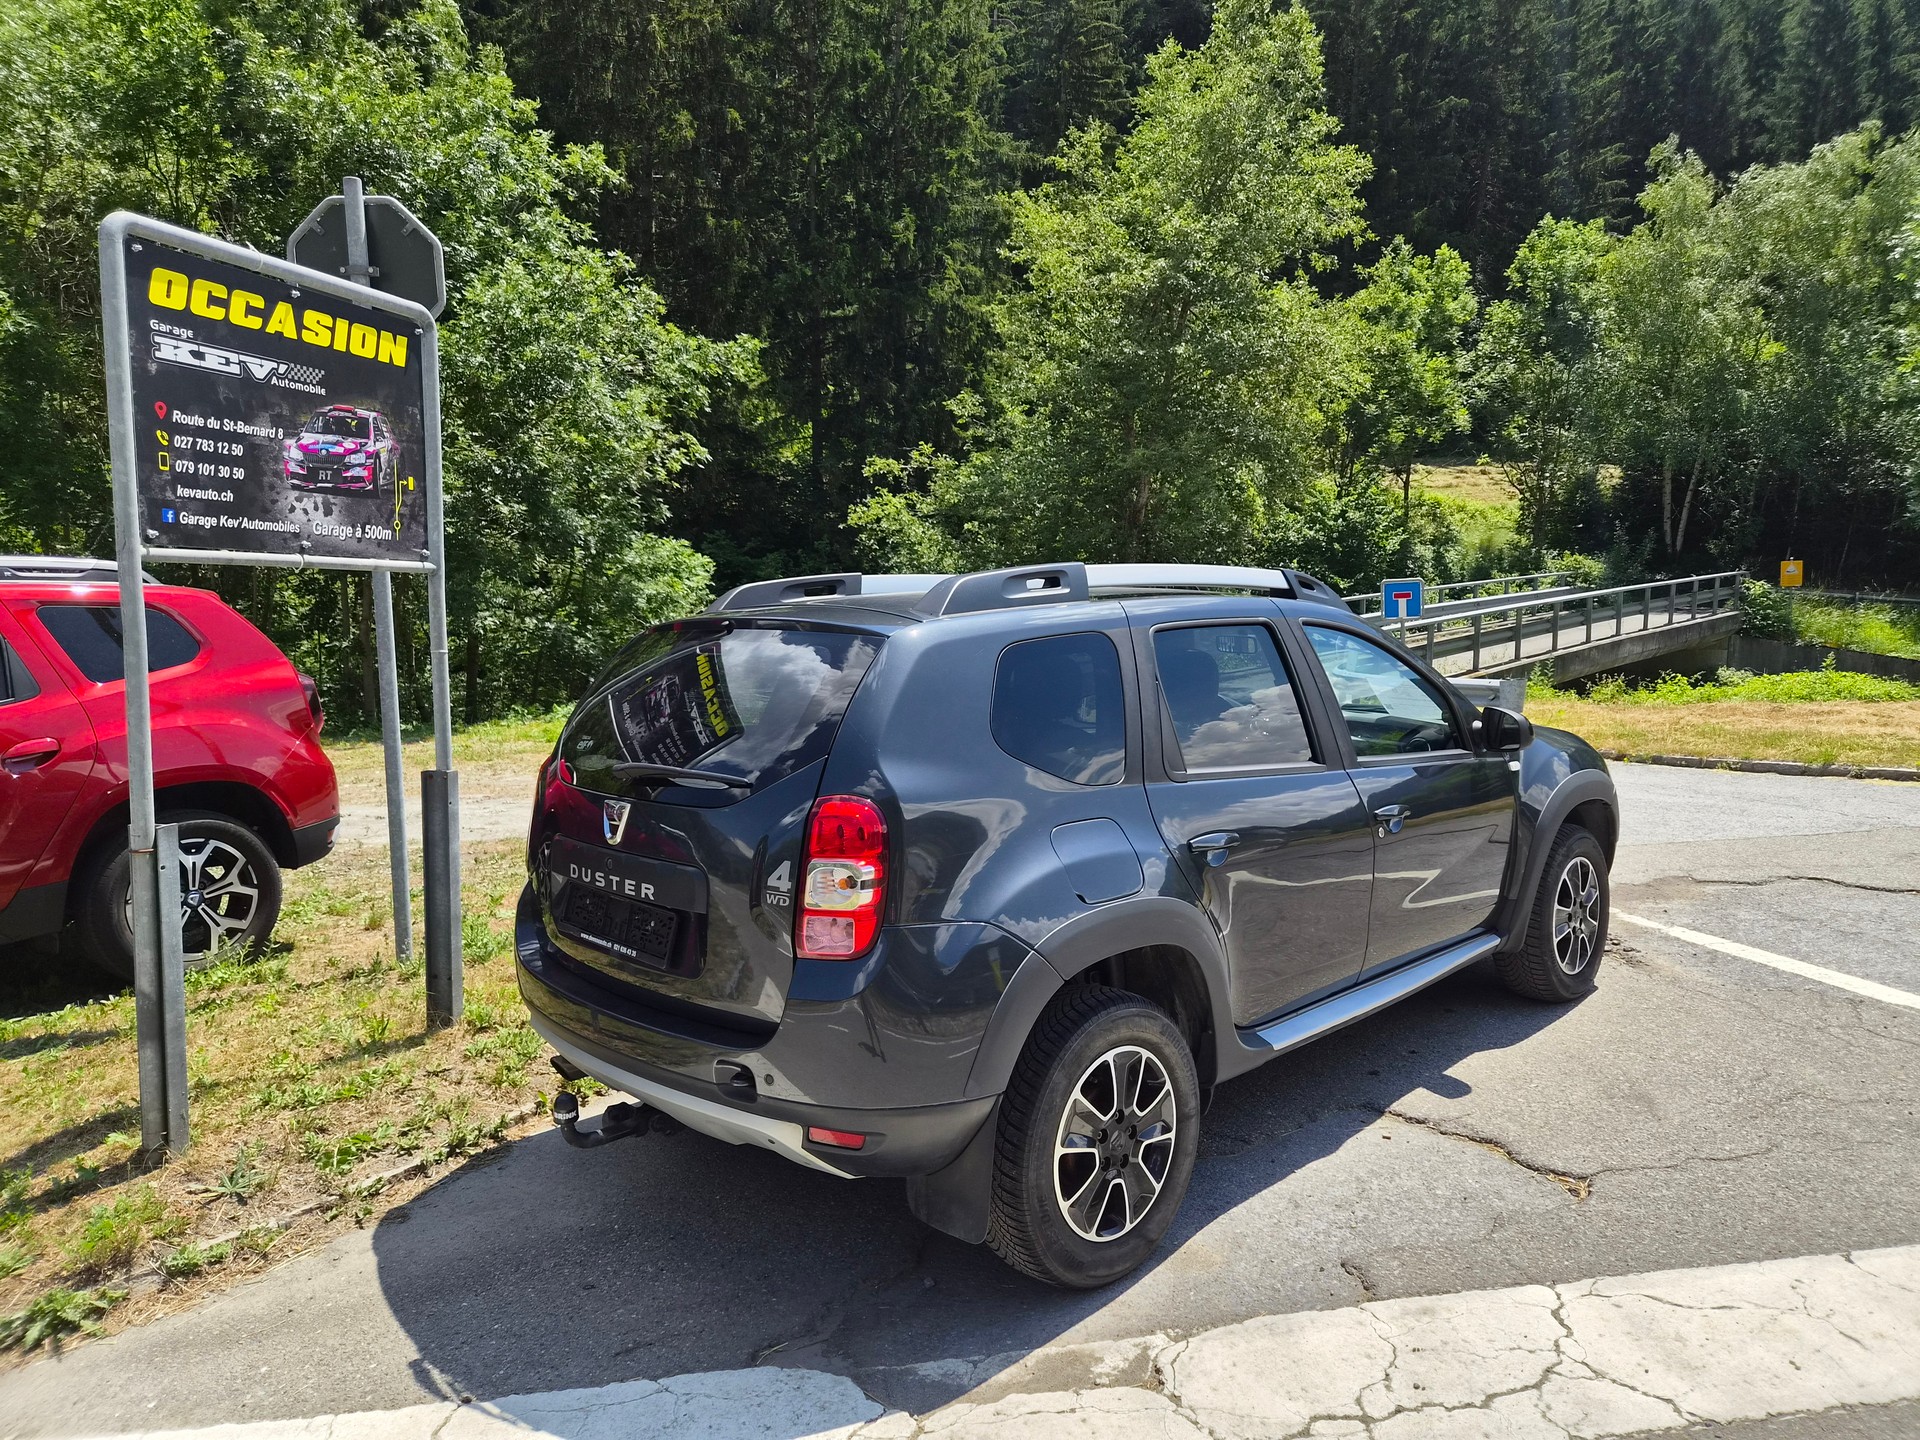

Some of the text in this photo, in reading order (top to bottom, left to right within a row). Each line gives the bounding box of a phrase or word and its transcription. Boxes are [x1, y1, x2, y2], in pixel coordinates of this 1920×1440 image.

[148, 267, 408, 368] OCCASION
[149, 319, 194, 340] Garage
[270, 375, 327, 396] Automobile
[172, 409, 284, 440] Route du St-Bernard 8
[173, 435, 244, 457] 027 783 12 50
[175, 460, 245, 480] 079 101 30 50
[318, 470, 333, 480] RT
[176, 484, 234, 502] kevauto.ch
[179, 511, 301, 534] Garage Kev'Automobiles
[312, 520, 392, 541] Garage à 500m
[570, 863, 655, 901] DUSTER
[767, 860, 792, 892] 4
[766, 893, 790, 907] WD
